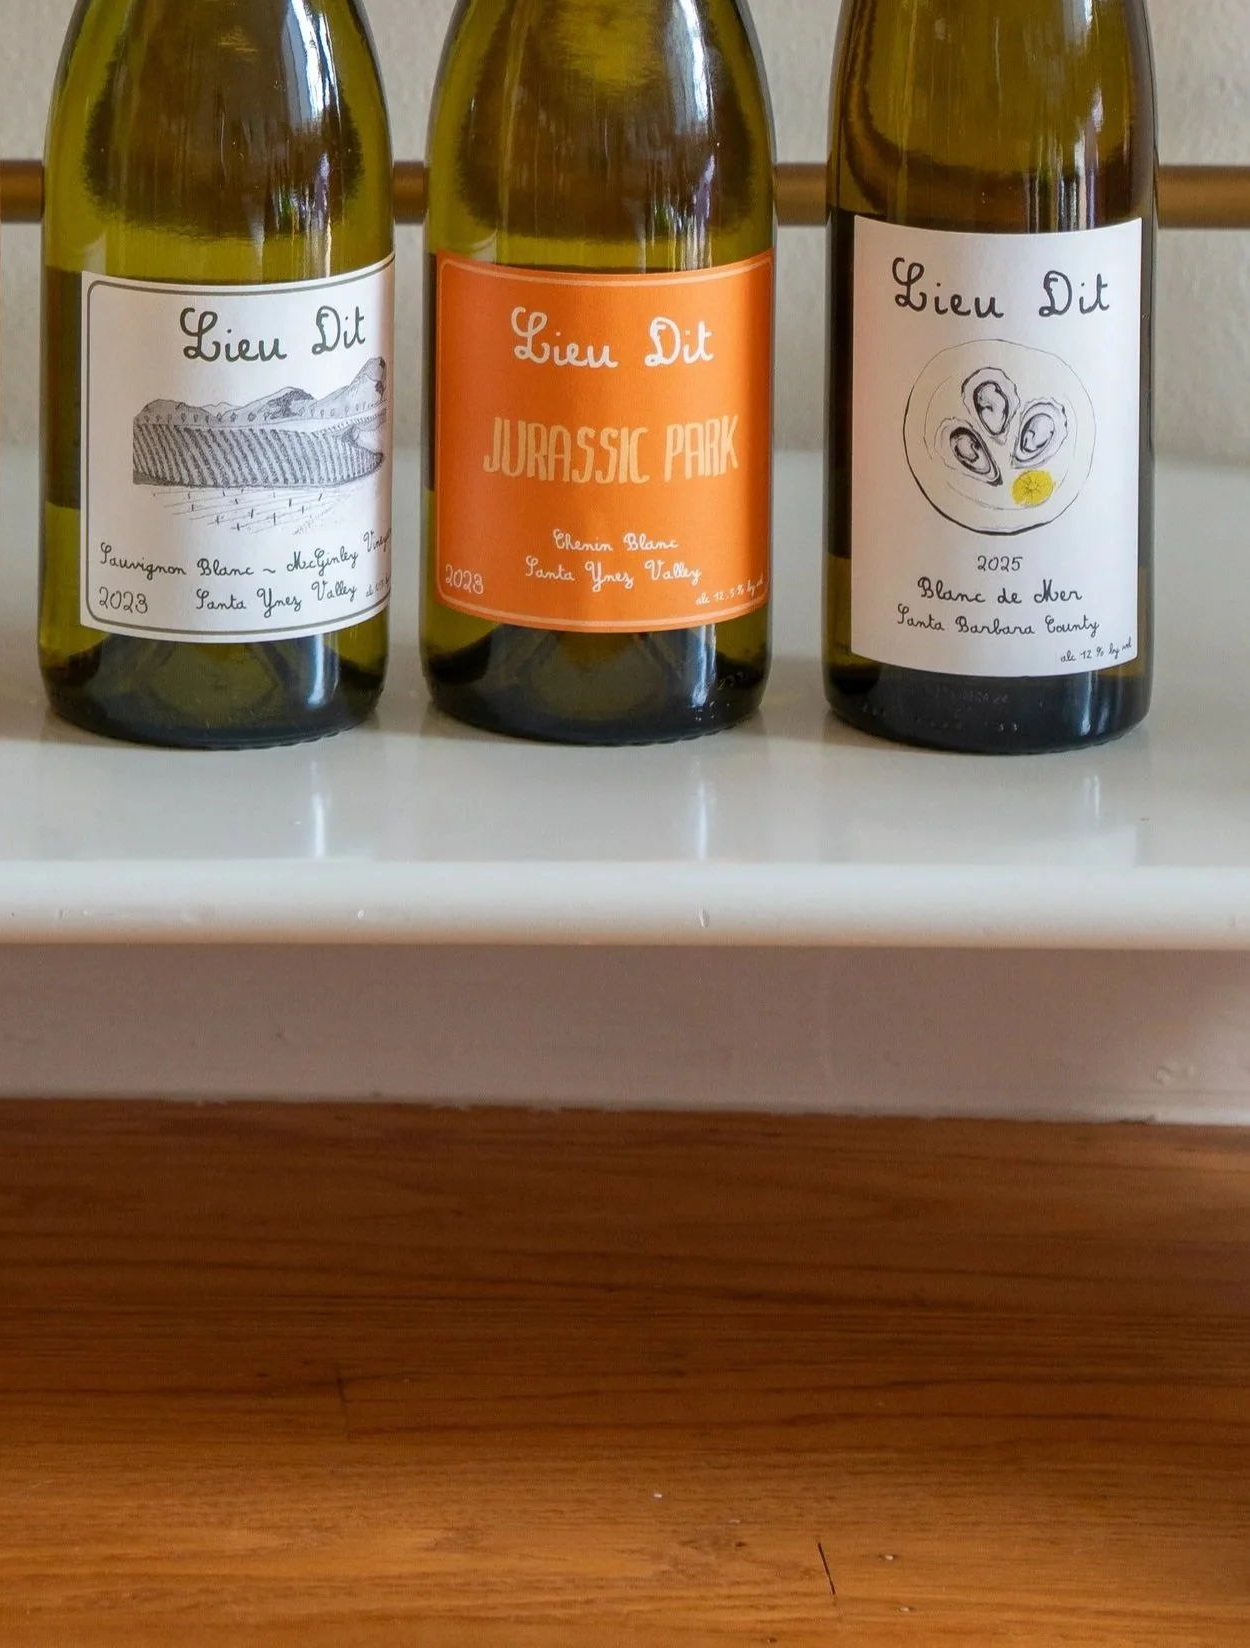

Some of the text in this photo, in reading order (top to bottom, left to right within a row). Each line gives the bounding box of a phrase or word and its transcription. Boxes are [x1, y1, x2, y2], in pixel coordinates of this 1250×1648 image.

[892, 257, 1110, 319] Lieu Dit
[180, 305, 366, 362] Lieu Dit
[511, 306, 714, 368] Lieu Dit
[483, 414, 739, 485] JURASSIC PARK
[552, 529, 678, 552] Chenin Blanc
[100, 542, 186, 580] Sauvignon
[196, 558, 254, 577] Blanc
[287, 546, 358, 577] McGinley
[445, 563, 484, 594] 2023
[525, 555, 702, 593] Santa Ynez Valley
[977, 555, 1023, 572] 2025
[98, 586, 148, 614] 2023
[195, 588, 247, 611] Santa
[256, 587, 302, 618] Ynez
[311, 580, 357, 602] Valley
[917, 577, 1083, 604] Blanc de Mer
[897, 605, 1100, 638] Santa Barbara County
[1060, 650, 1077, 663] alc
